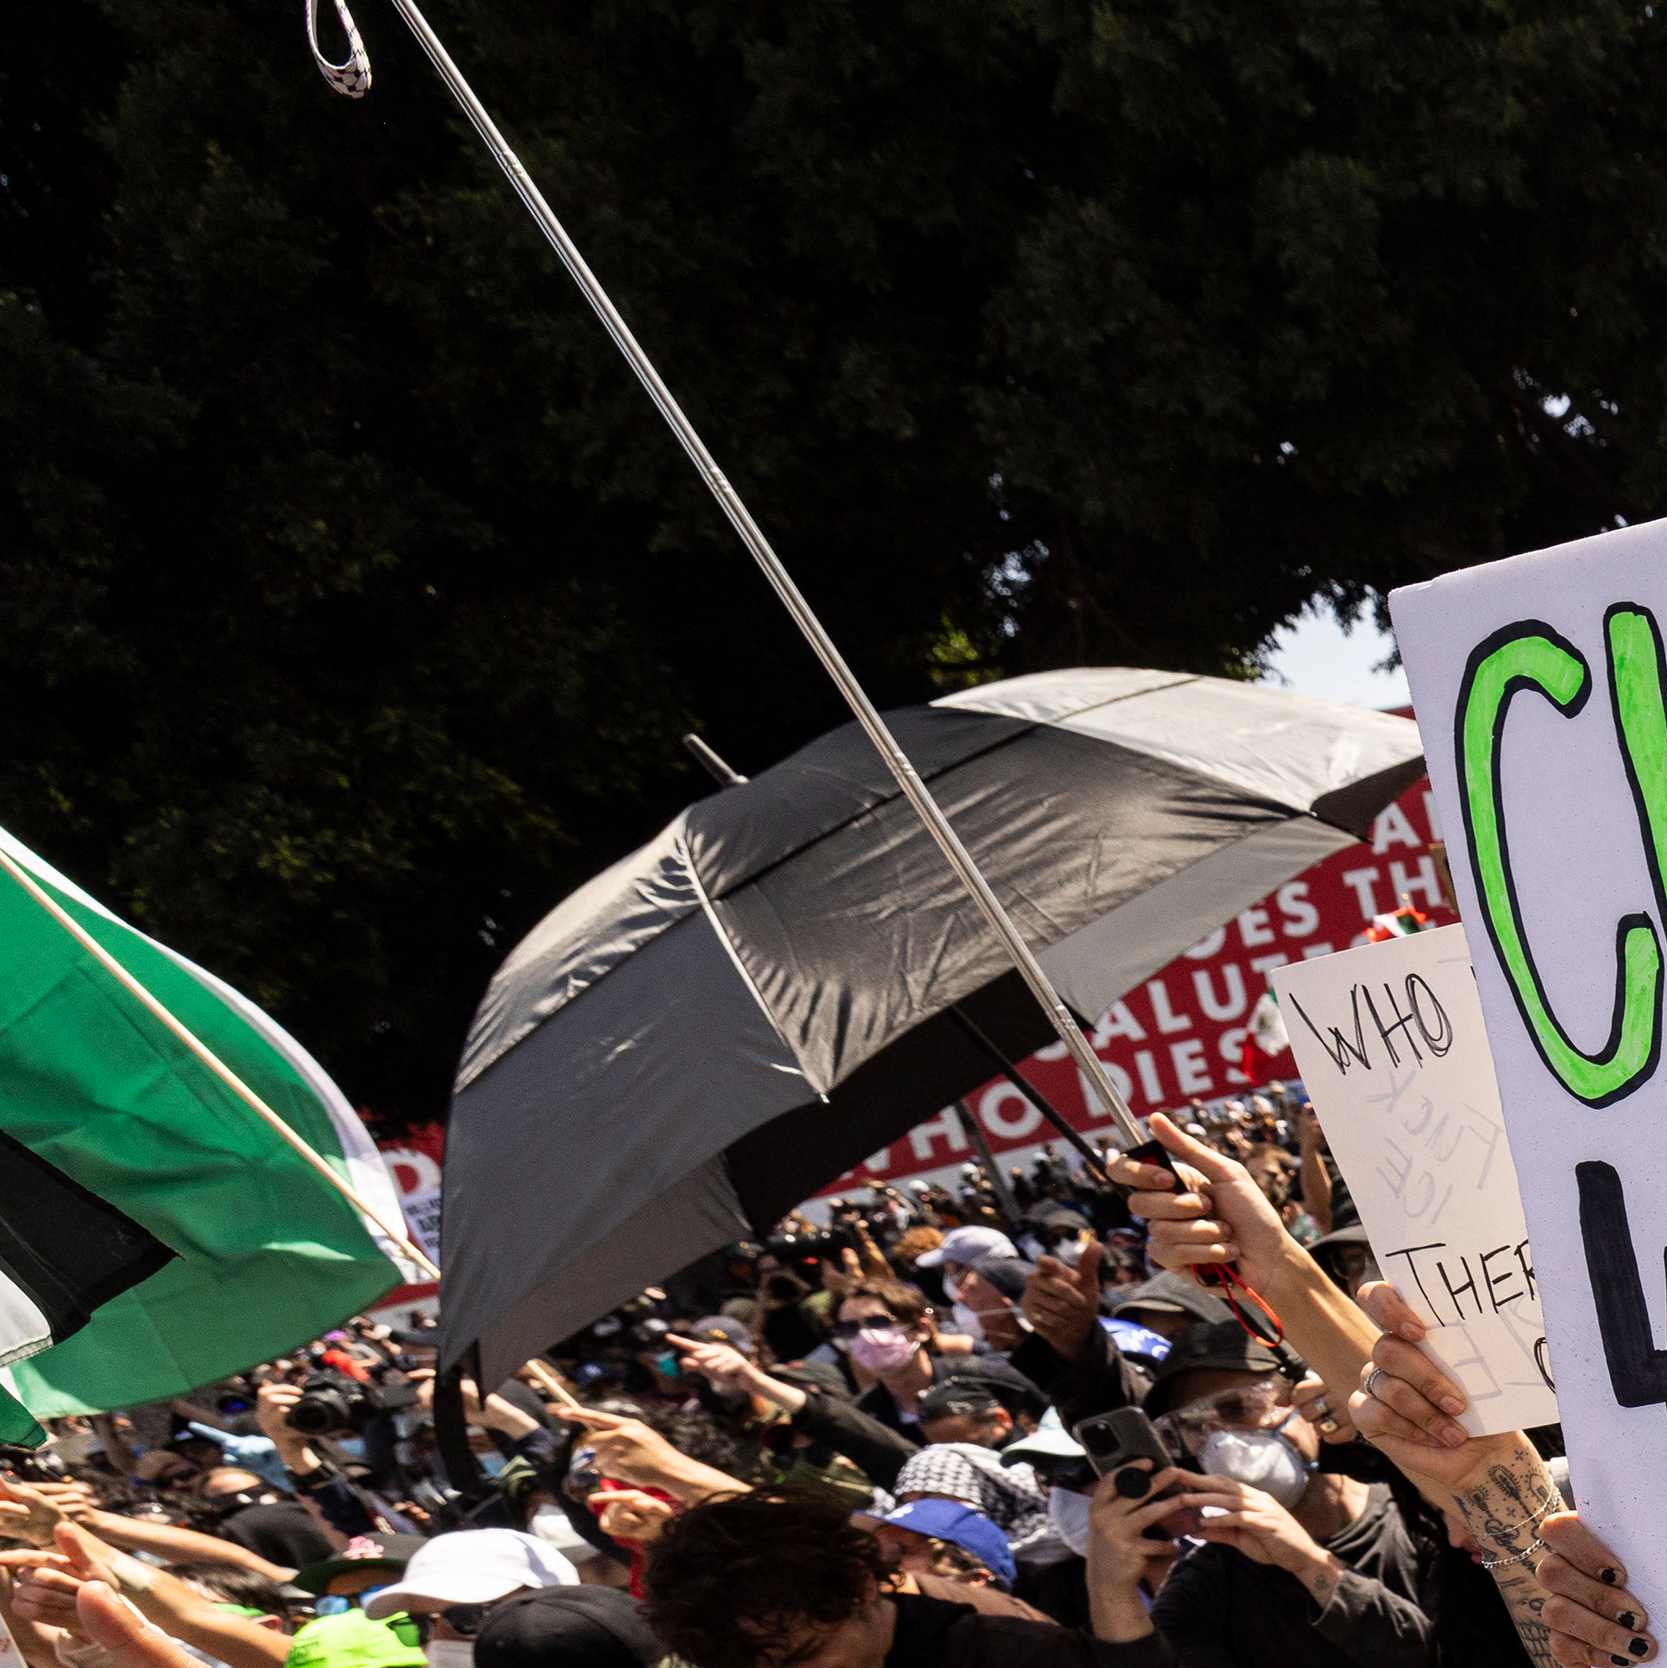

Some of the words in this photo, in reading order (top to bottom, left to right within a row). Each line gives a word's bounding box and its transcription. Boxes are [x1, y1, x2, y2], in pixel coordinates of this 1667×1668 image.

[1183, 880, 1320, 959] ES
[1289, 973, 1453, 1075] WHO
[841, 1081, 1044, 1180] HO
